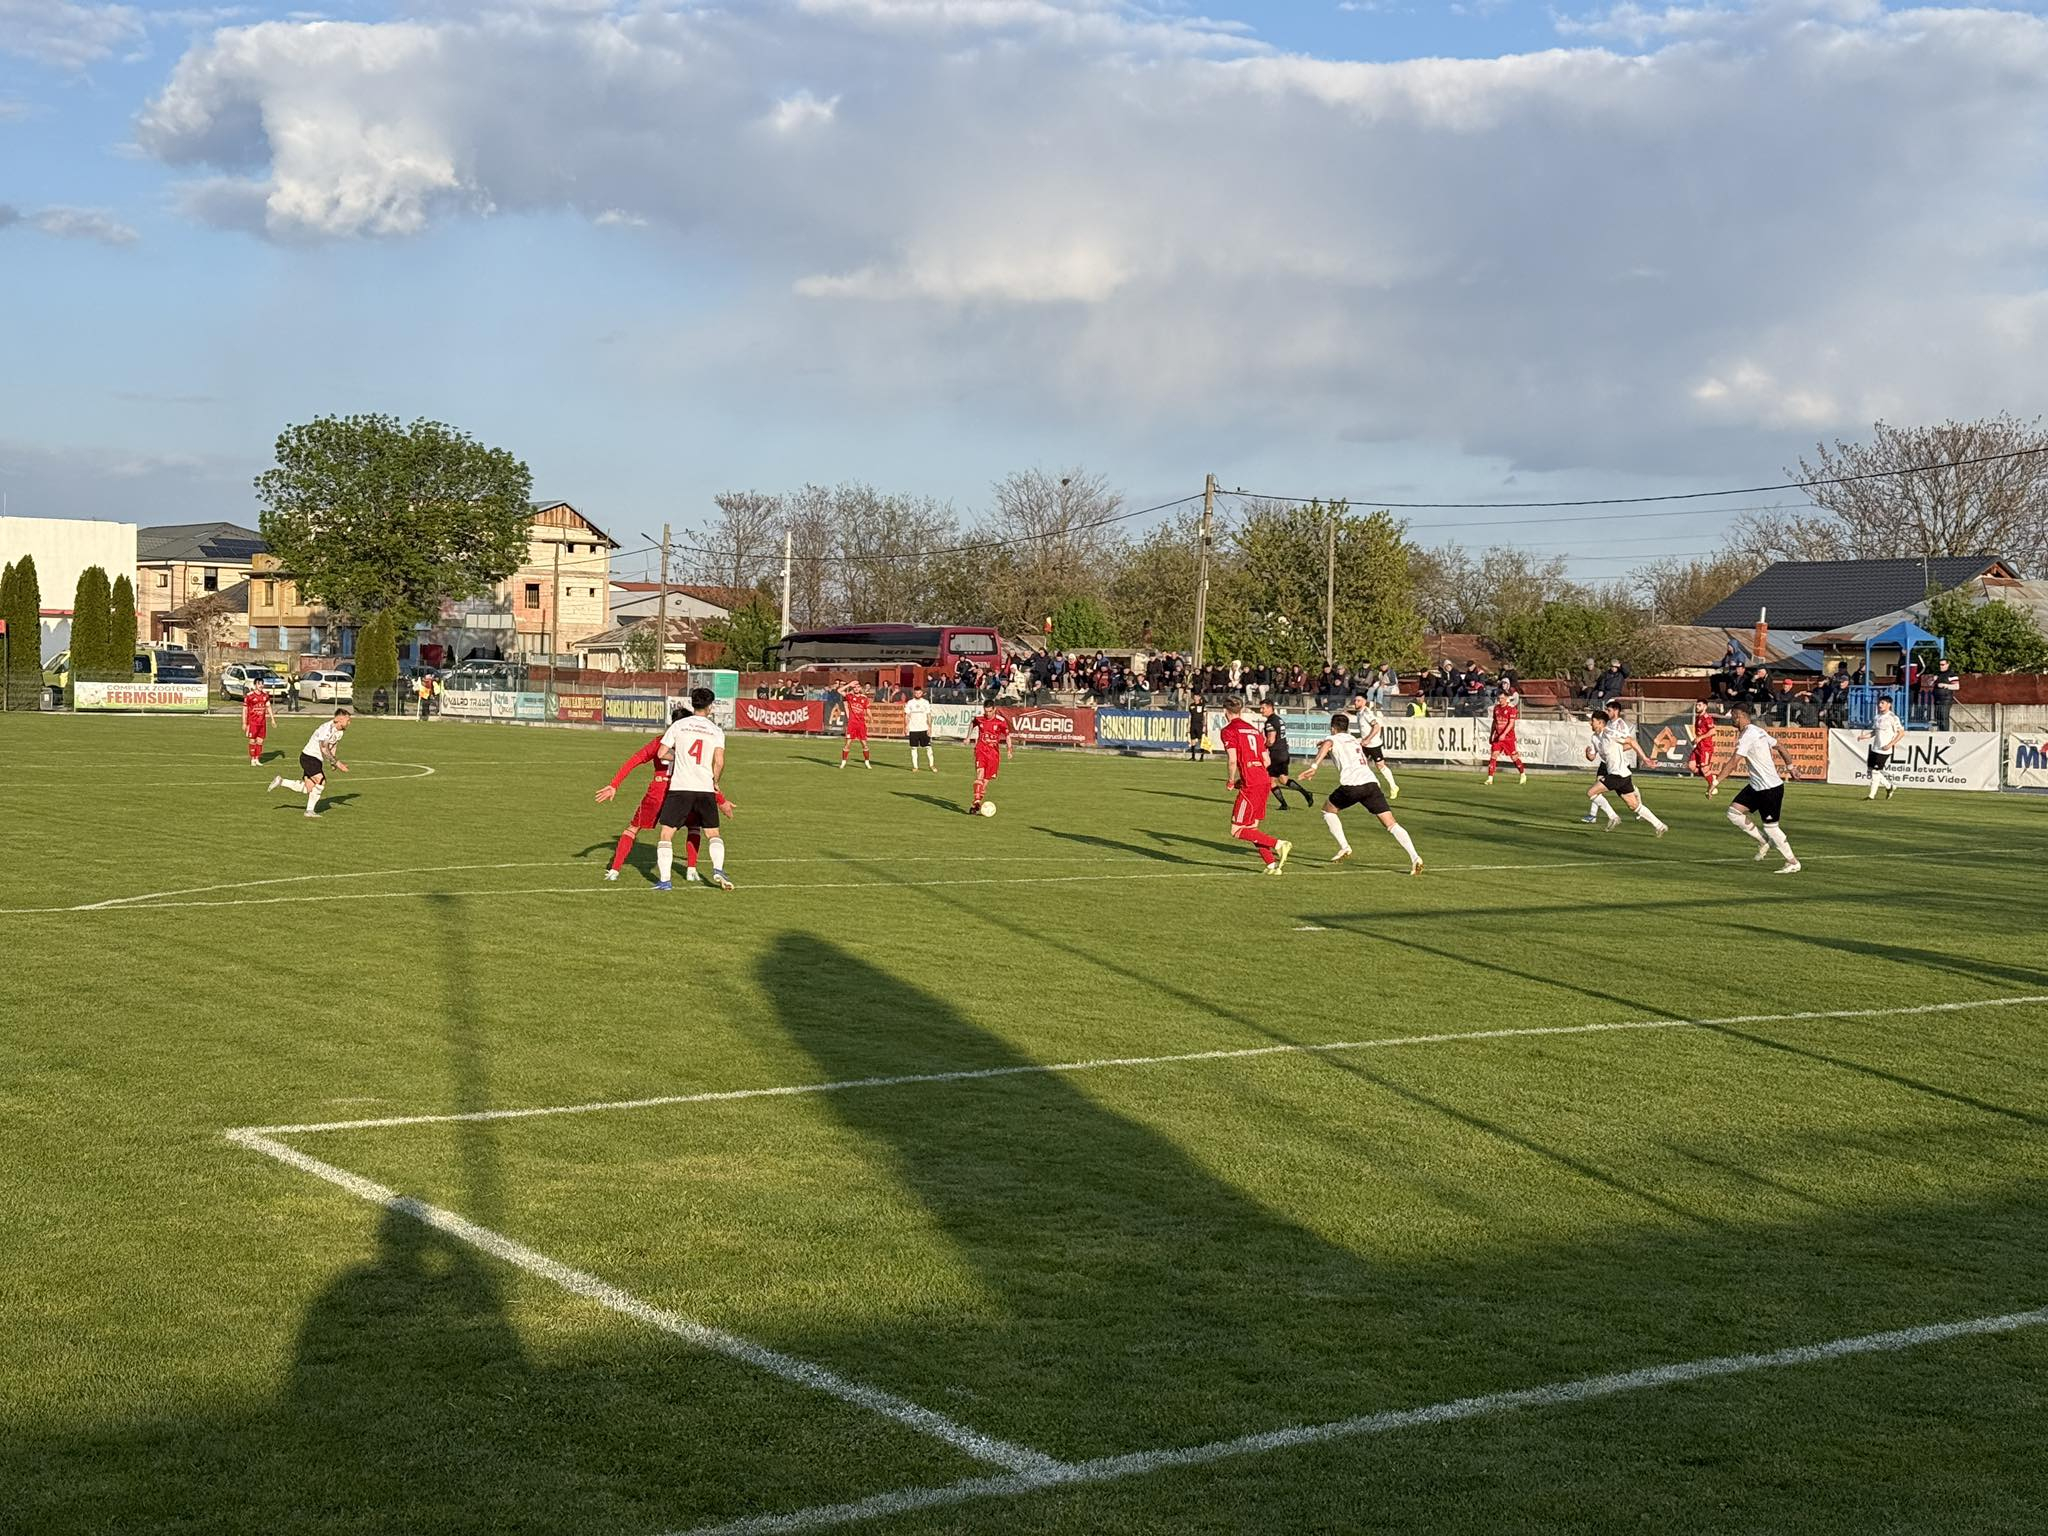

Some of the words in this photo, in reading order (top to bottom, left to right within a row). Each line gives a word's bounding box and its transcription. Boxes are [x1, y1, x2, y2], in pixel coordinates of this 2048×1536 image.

[107, 691, 183, 705] FERMSUIN
[747, 704, 810, 726] SUPERSCORE
[1012, 717, 1074, 733] VALGRIG
[1101, 715, 1147, 740] CONSILIUL
[1148, 716, 1175, 742] LOCAL
[1380, 726, 1407, 750] ADER
[688, 738, 703, 765] 4
[1247, 734, 1258, 758] 9
[1783, 743, 1824, 752] ONSTRUCȚIE
[1902, 772, 1927, 783] Foto
[1928, 774, 1936, 783] &
[1937, 774, 1967, 784] Video
